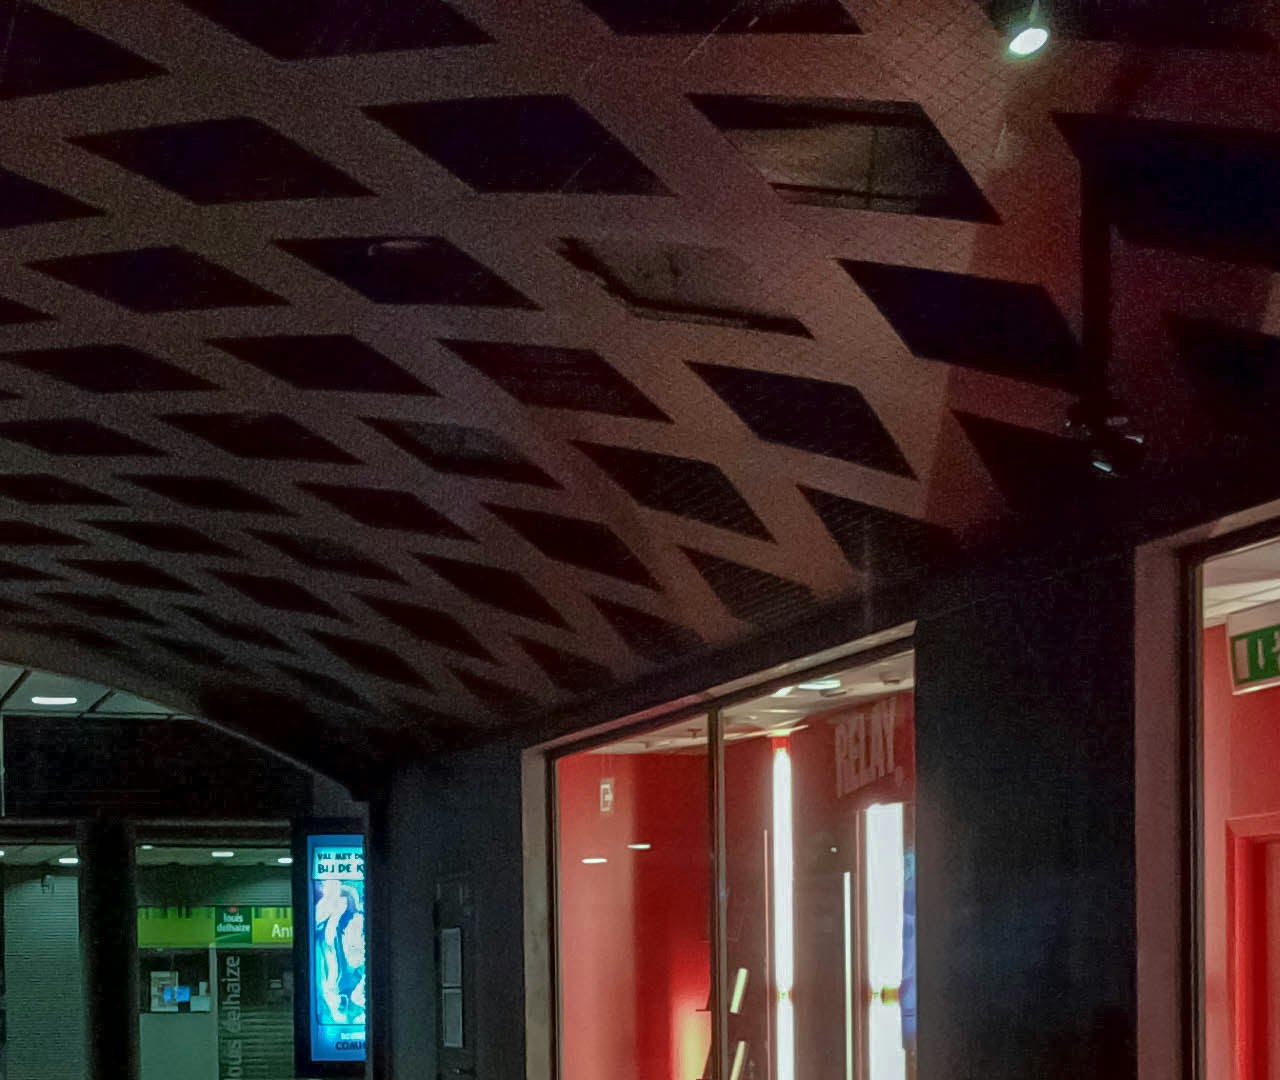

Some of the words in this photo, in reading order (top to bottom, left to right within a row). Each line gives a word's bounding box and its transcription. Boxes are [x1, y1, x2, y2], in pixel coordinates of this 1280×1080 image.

[835, 697, 897, 799] RELAY
[338, 863, 352, 873] DE
[224, 912, 243, 923] louis
[216, 923, 251, 933] delhaize
